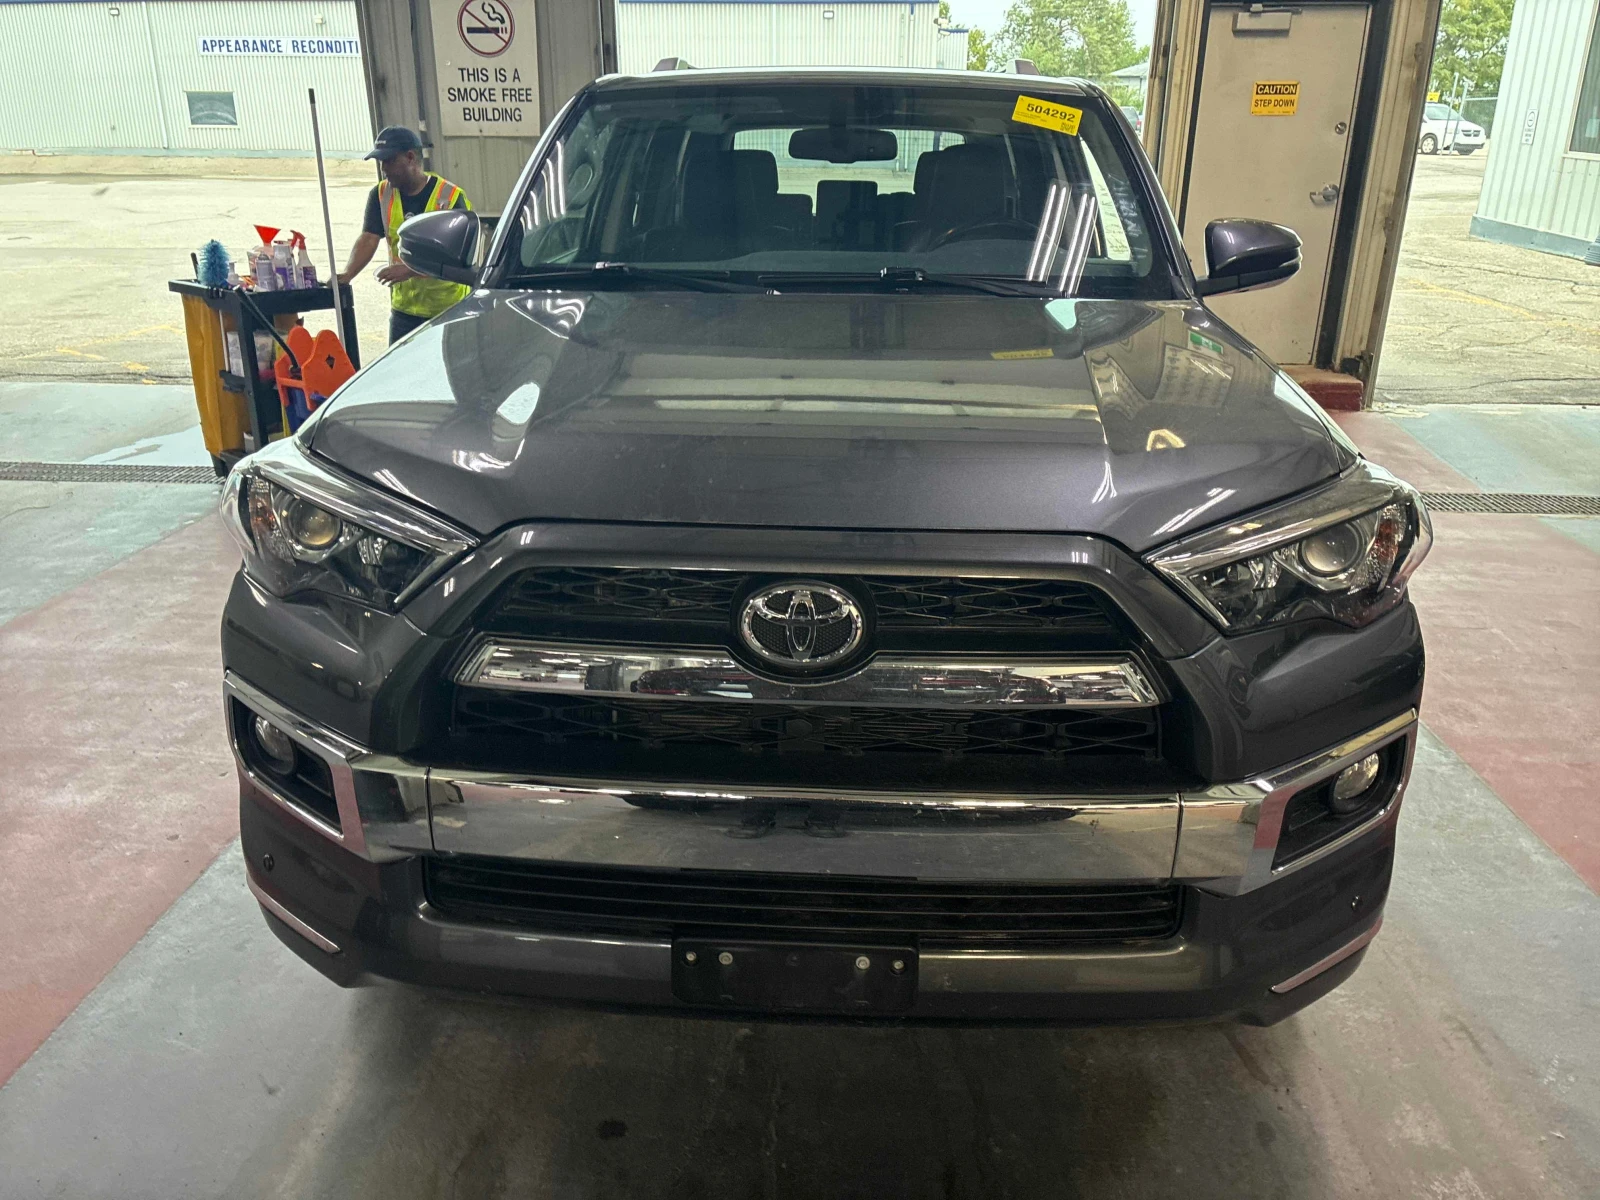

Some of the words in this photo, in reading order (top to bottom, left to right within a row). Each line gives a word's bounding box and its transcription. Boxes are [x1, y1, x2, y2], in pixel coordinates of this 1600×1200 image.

[202, 39, 283, 53] APPEARANCE
[458, 67, 489, 83] THIS
[495, 68, 507, 83] IS
[512, 68, 521, 83] A
[447, 87, 496, 103] SMOKE
[502, 88, 533, 103] FREE
[1257, 85, 1296, 94] CAUTION
[1254, 98, 1272, 107] STEP
[1273, 98, 1295, 107] DOWN
[463, 107, 522, 122] BUILDING
[1026, 103, 1076, 122] 504292
